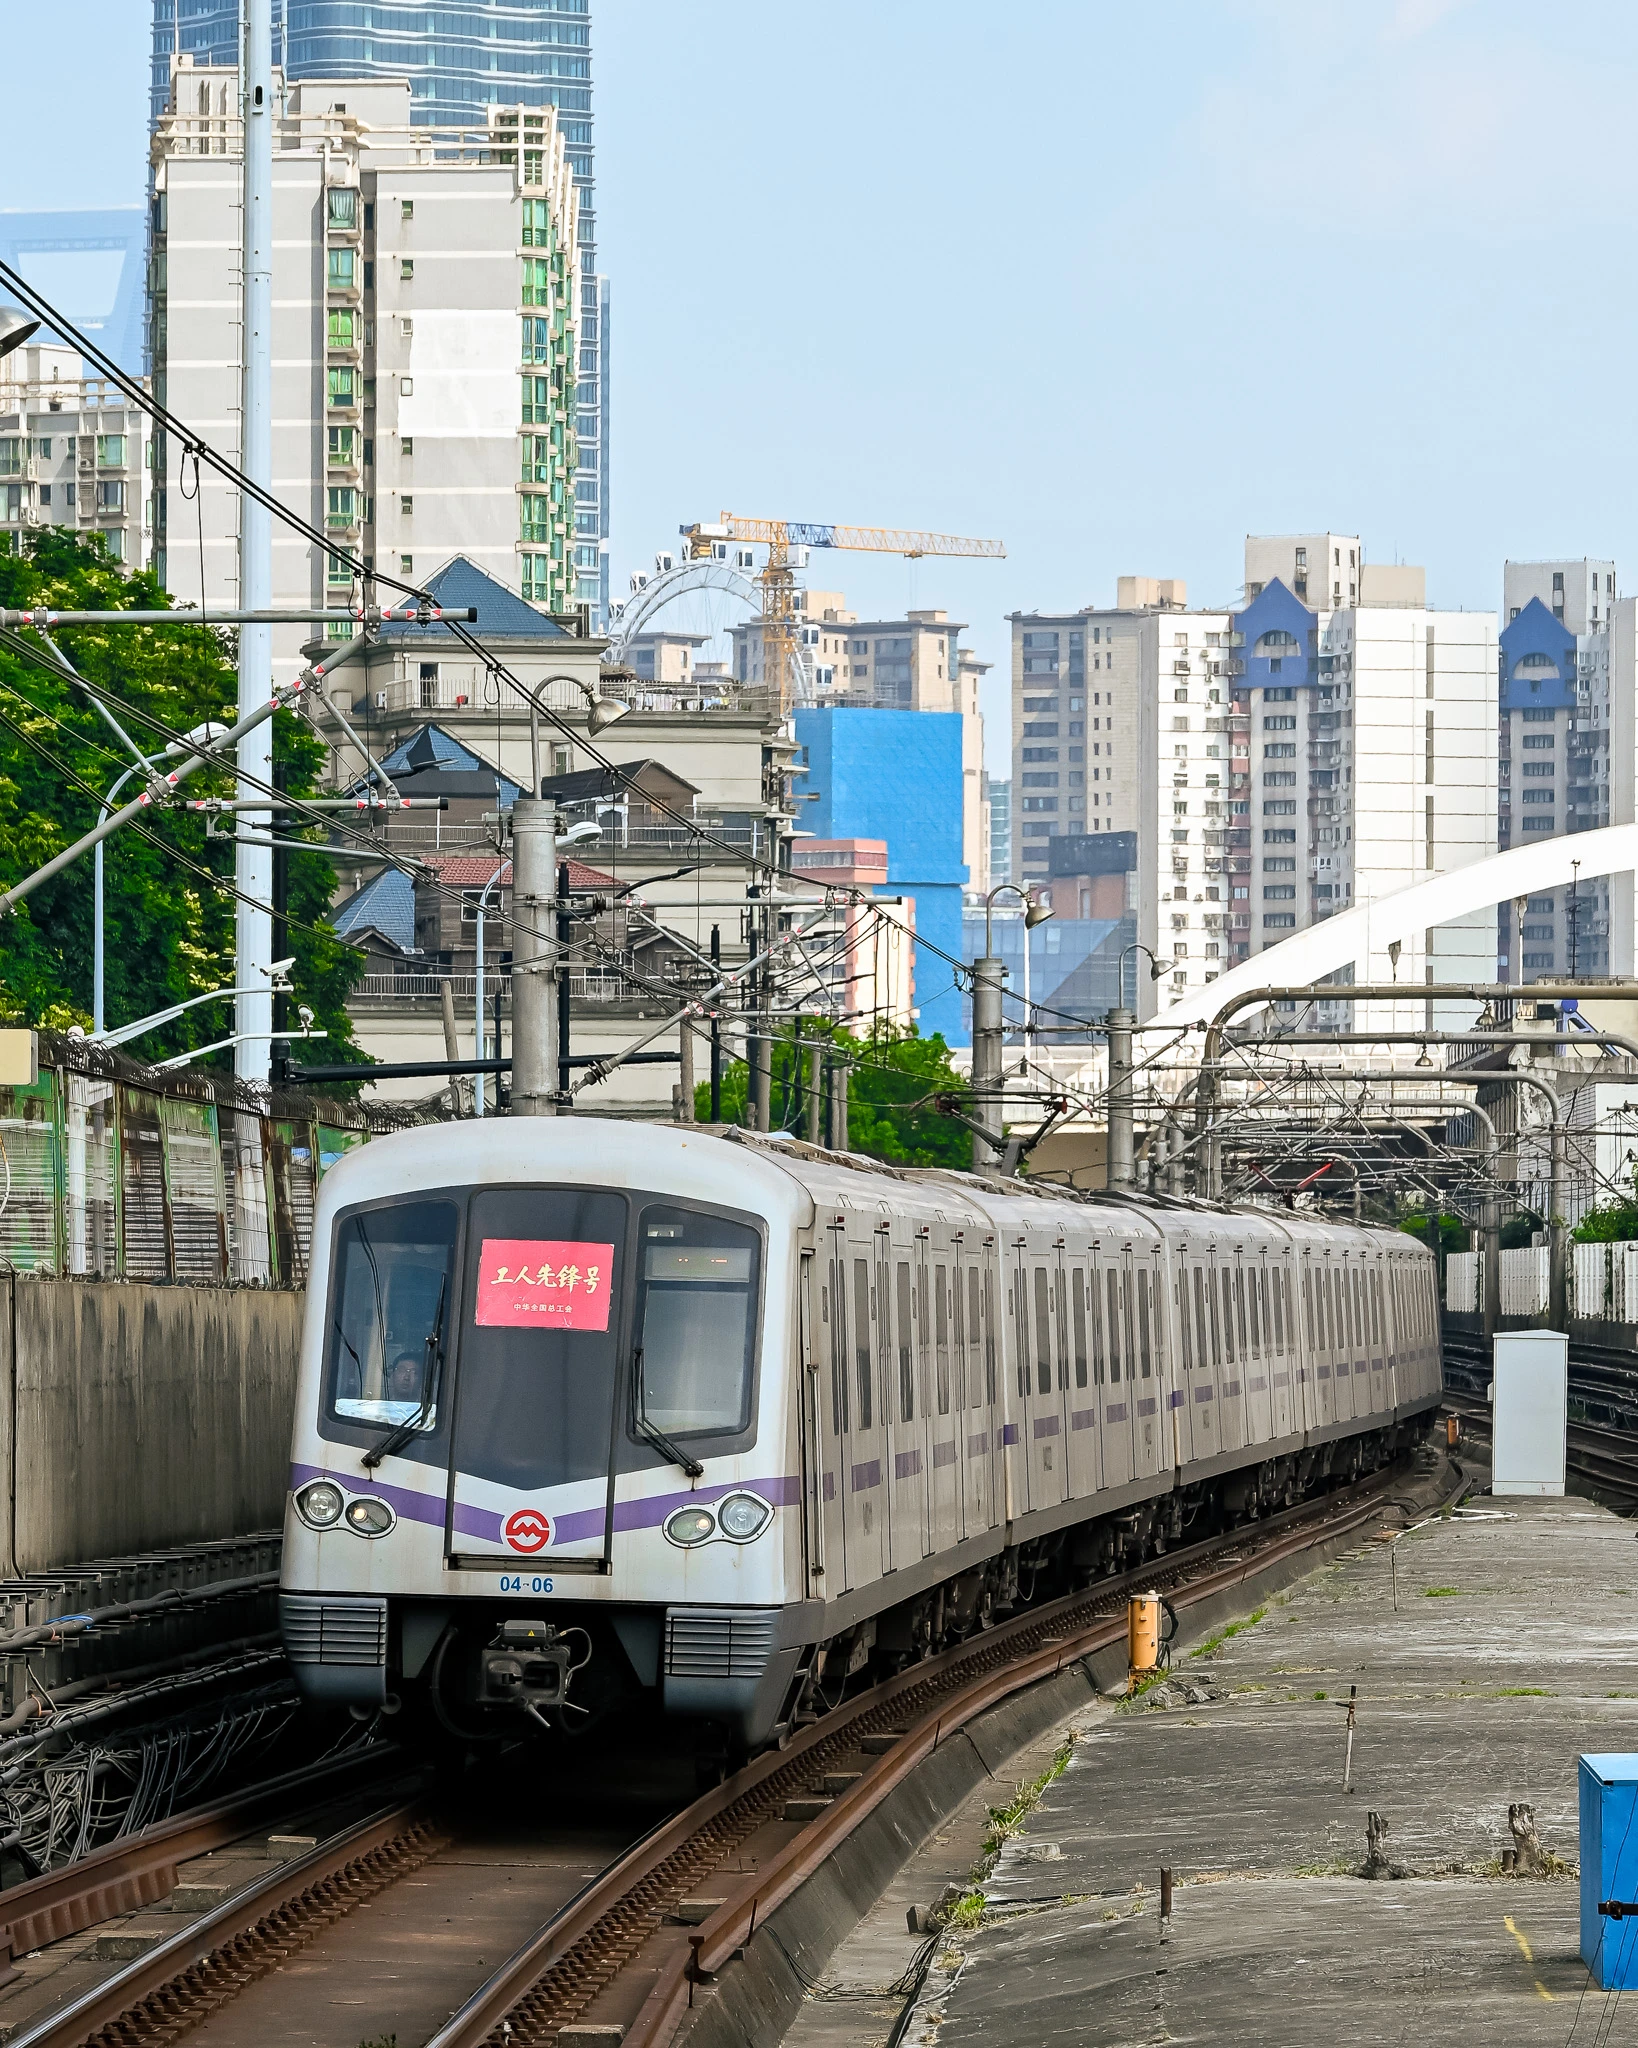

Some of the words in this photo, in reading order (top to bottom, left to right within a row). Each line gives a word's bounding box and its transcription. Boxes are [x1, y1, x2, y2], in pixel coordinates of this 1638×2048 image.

[491, 1263, 600, 1294] 工人先锋号
[514, 1304, 572, 1313] 中华全国总工会
[500, 1576, 553, 1593] 04-06
